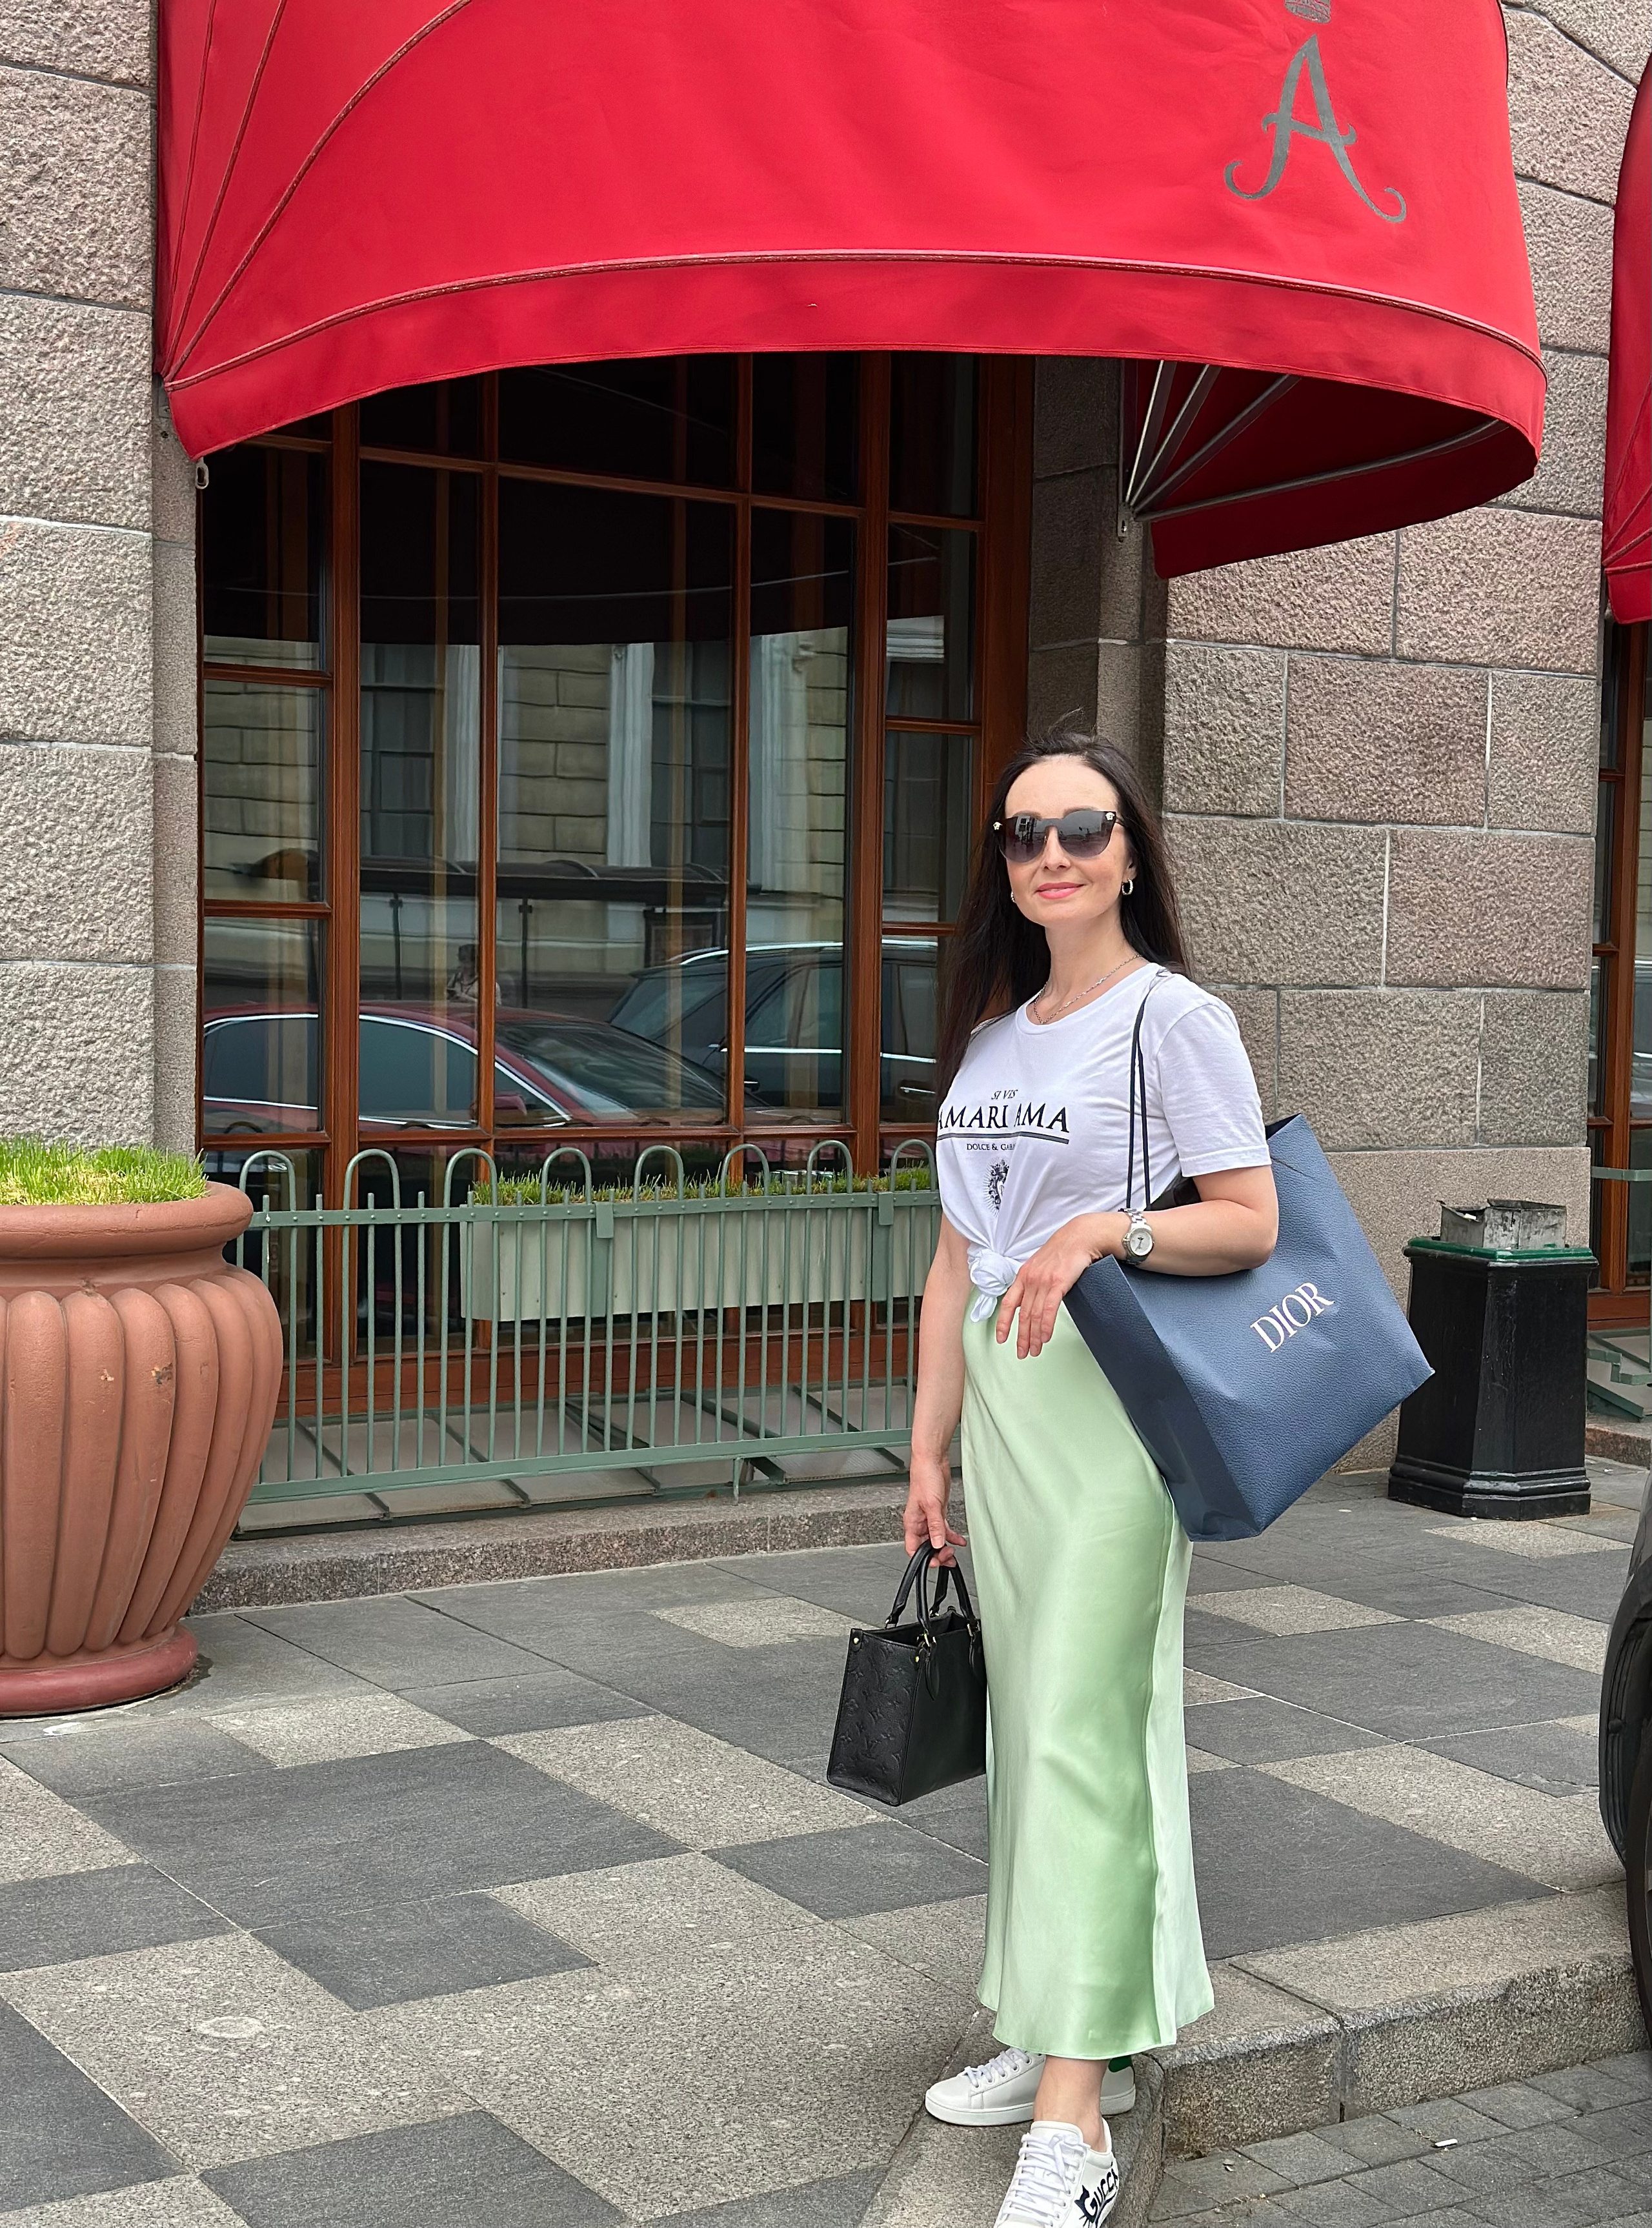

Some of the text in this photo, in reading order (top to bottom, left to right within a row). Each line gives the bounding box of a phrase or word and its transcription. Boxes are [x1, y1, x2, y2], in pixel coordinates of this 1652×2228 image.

[1224, 34, 1407, 223] A
[991, 1089, 1018, 1100] SI VIS
[1250, 1282, 1335, 1353] DIOR
